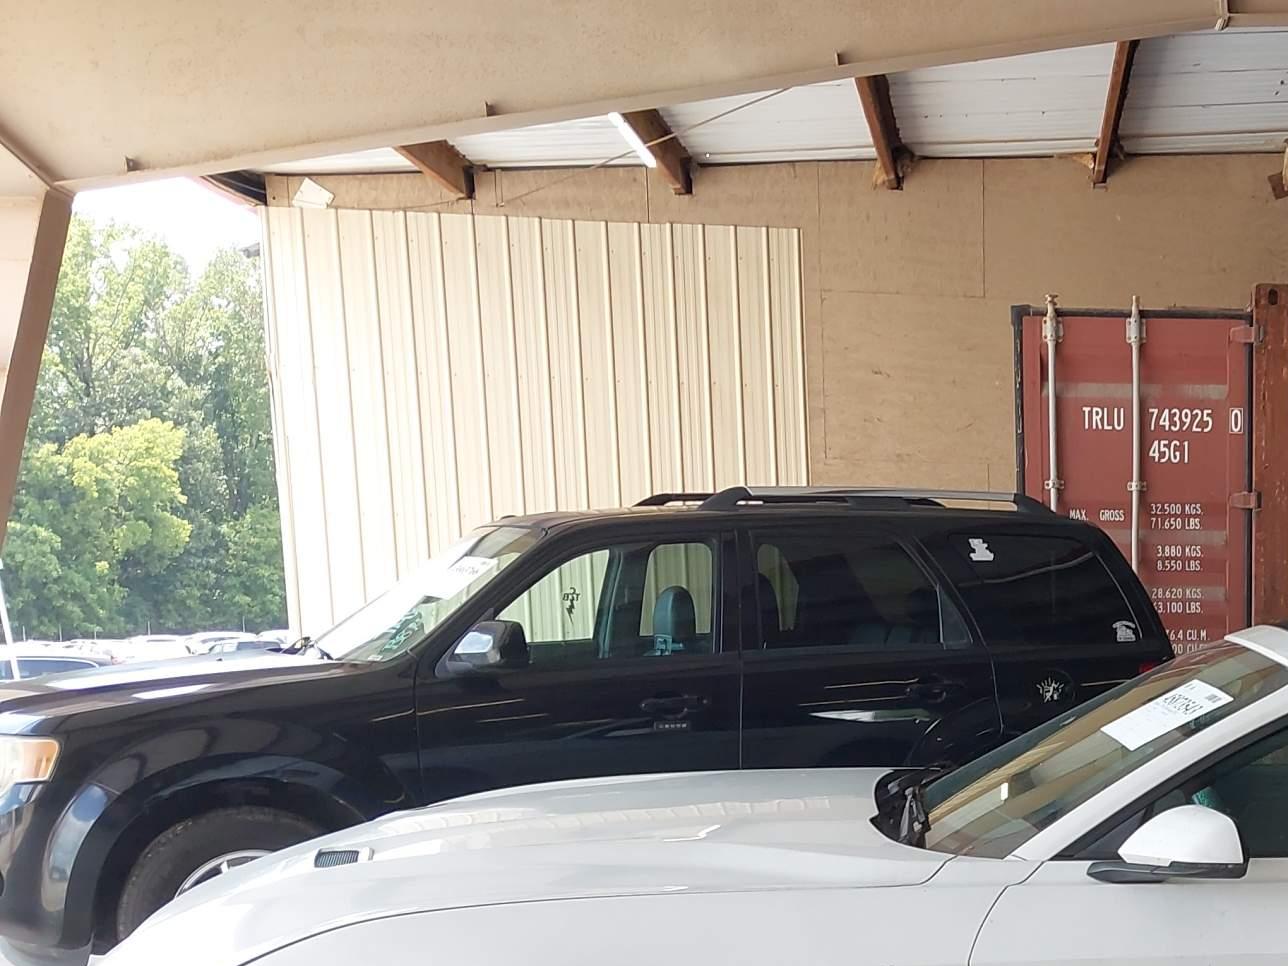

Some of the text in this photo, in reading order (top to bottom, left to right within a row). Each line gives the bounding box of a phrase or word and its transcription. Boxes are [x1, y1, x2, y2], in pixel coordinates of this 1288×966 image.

[1082, 407, 1242, 432] TRLU 743925 0
[1149, 440, 1190, 463] 45G1
[1069, 509, 1125, 521] MAX. GROSS
[1150, 503, 1204, 515] 32.500 KGS.
[1150, 517, 1203, 530] 71.650 LBS.
[1185, 545, 1204, 558] KGS.
[1185, 560, 1204, 572] LBS.
[1186, 601, 1204, 613] LBS.
